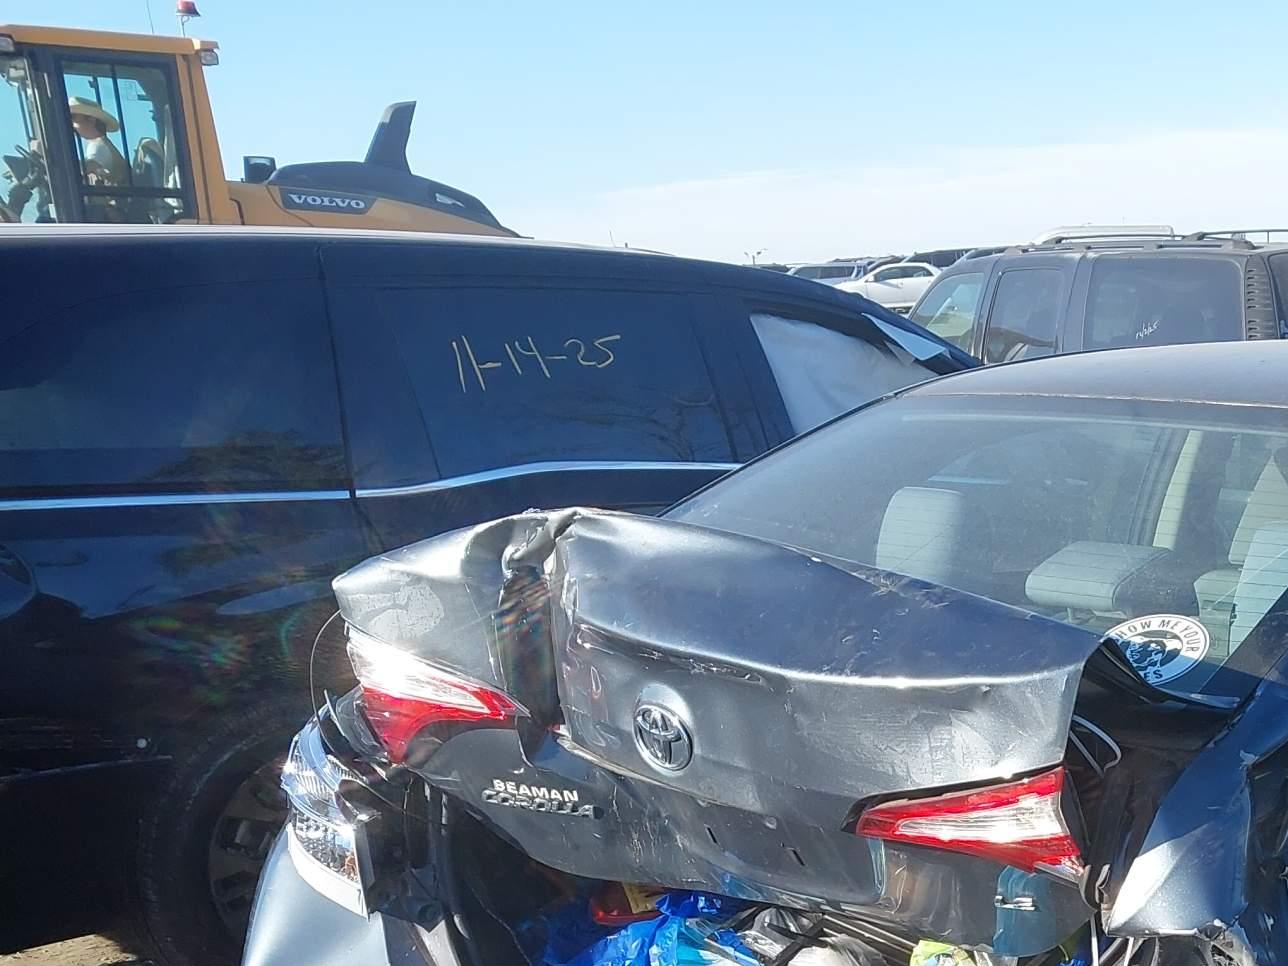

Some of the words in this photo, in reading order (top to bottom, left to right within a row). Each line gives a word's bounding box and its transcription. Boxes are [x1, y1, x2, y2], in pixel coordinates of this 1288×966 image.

[288, 193, 365, 209] VOLVO
[452, 335, 621, 393] 11-14-25
[1115, 620, 1151, 641] HOW
[1158, 619, 1181, 630] ME
[1180, 625, 1201, 652] YOUR
[493, 779, 579, 802] BEAMAN
